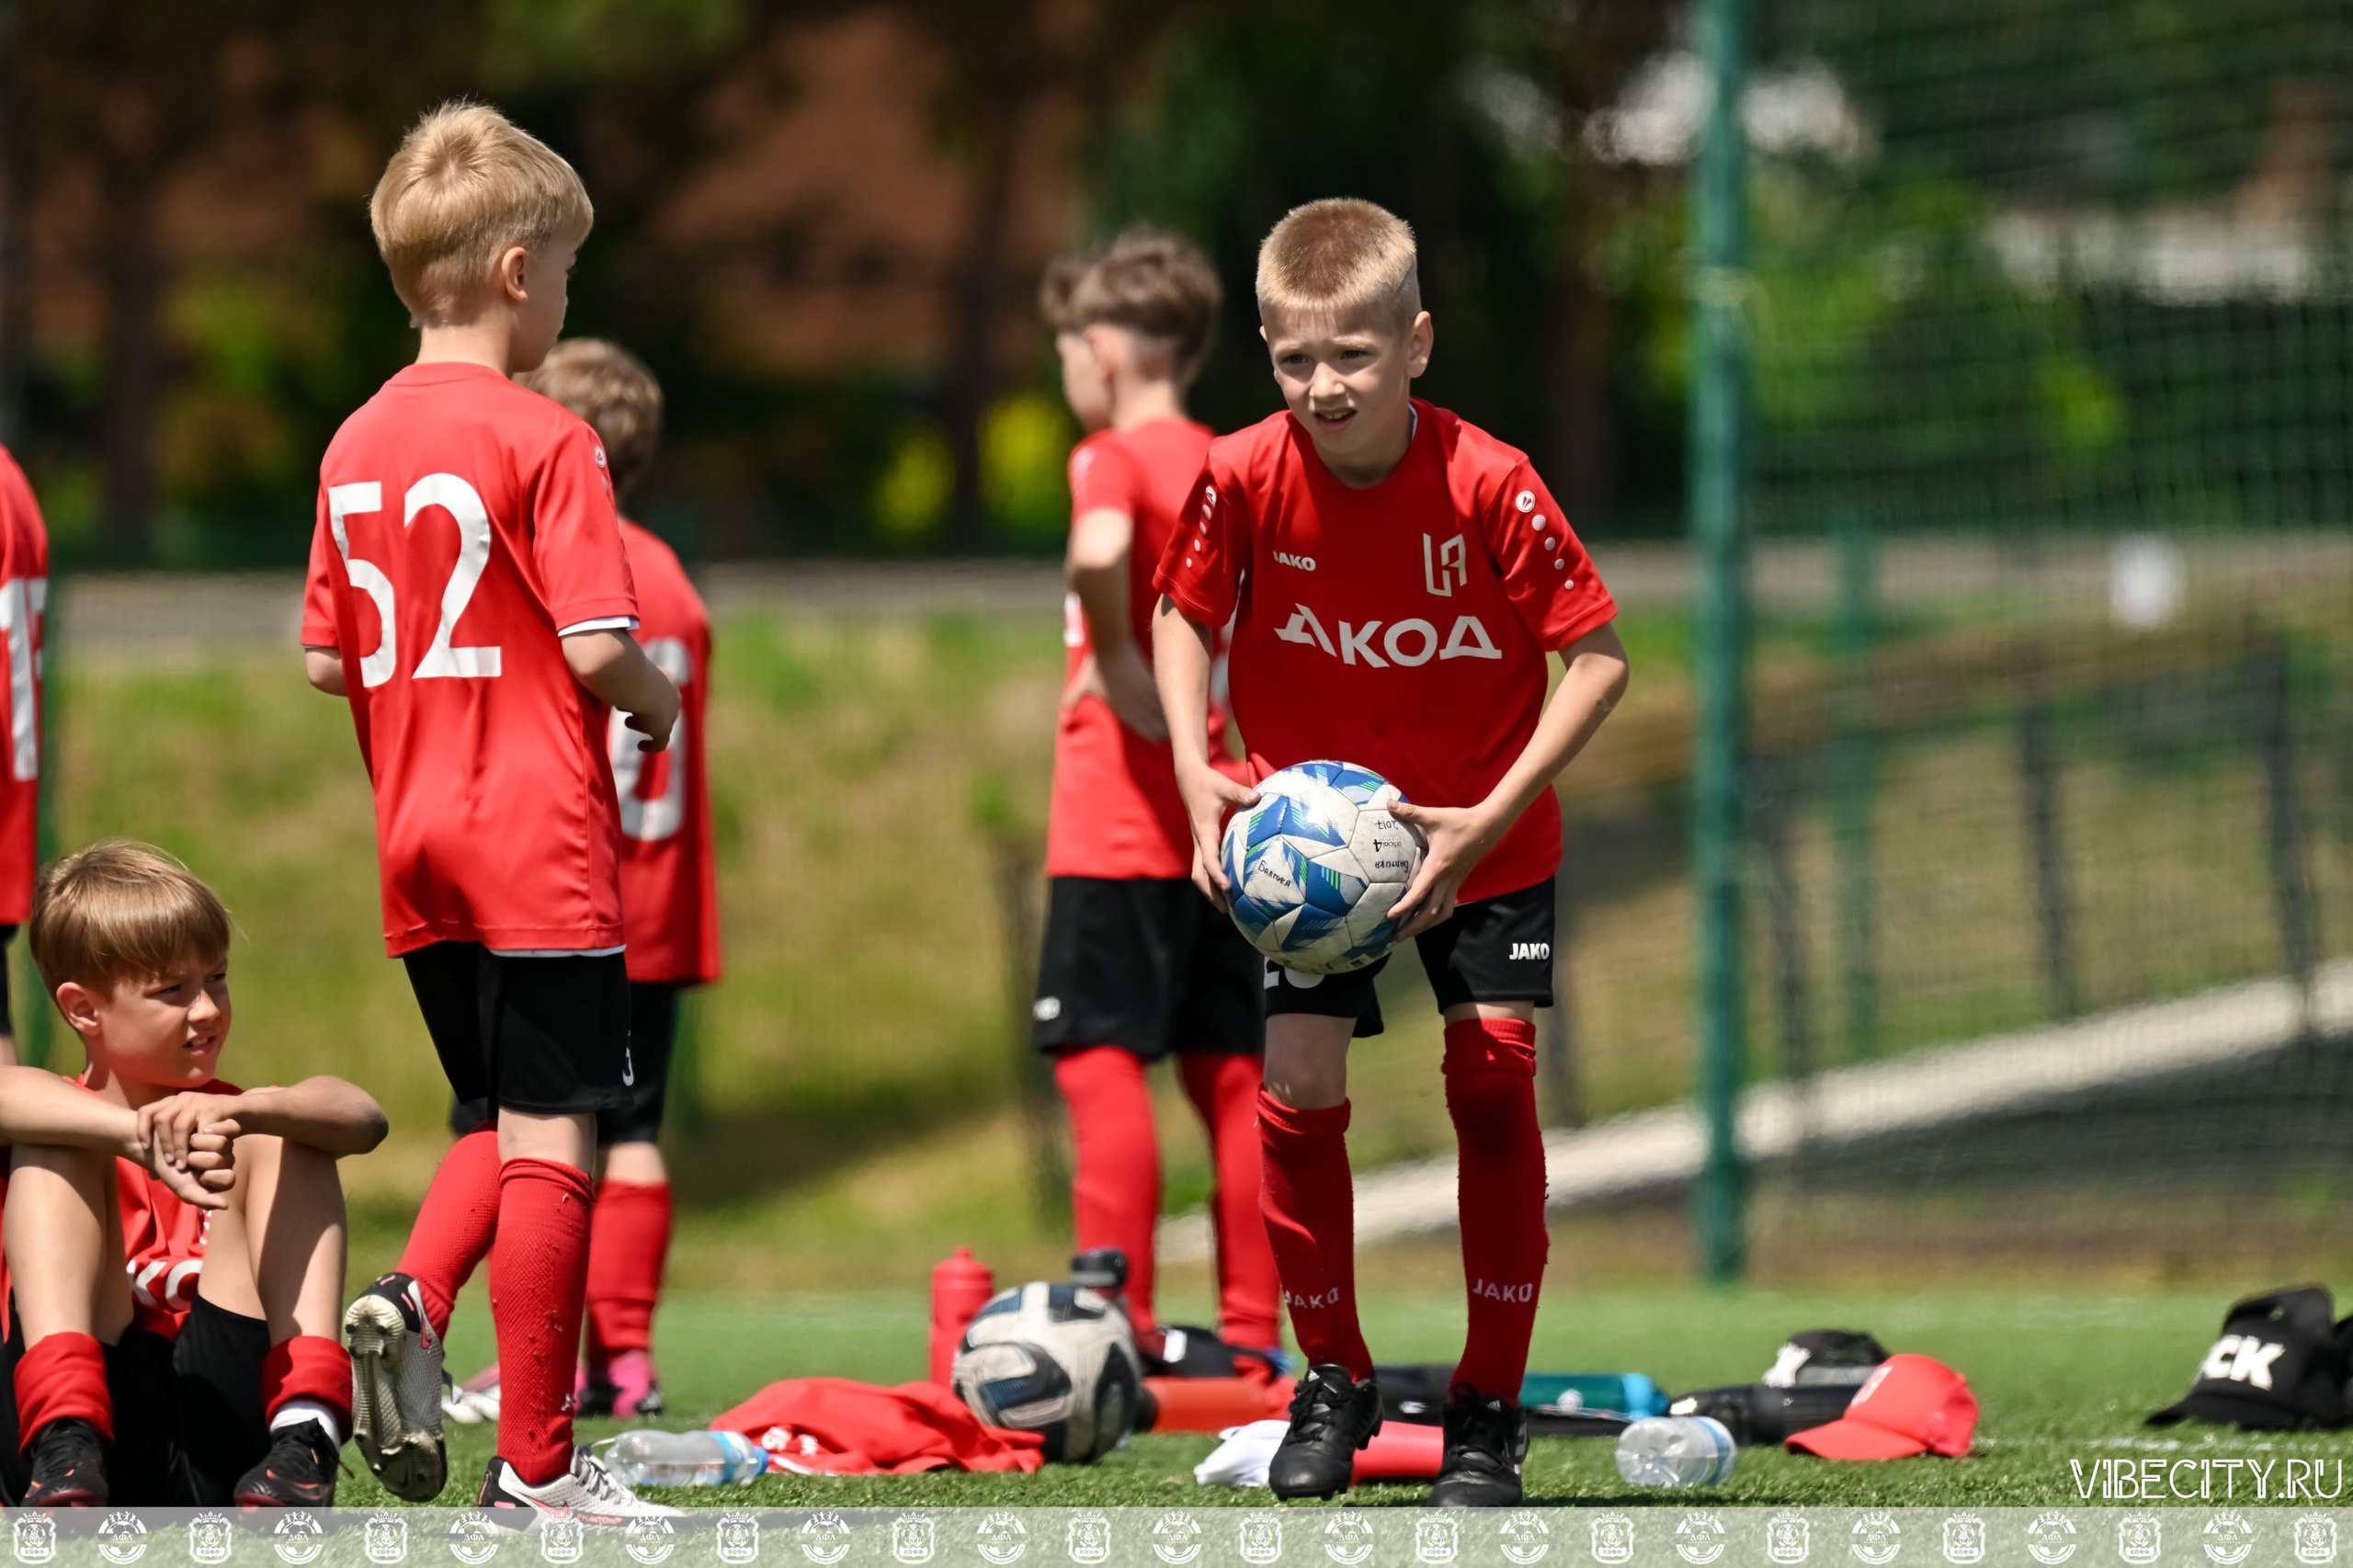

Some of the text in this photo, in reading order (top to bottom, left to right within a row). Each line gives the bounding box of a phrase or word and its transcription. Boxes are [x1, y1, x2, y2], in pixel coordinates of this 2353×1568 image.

[327, 472, 502, 688] 52
[1374, 819, 1399, 831] 2017
[1373, 838, 1382, 853] 4
[1508, 942, 1551, 960] JAKO
[1284, 1287, 1340, 1309] JAKO
[1472, 1278, 1534, 1303] JAKO
